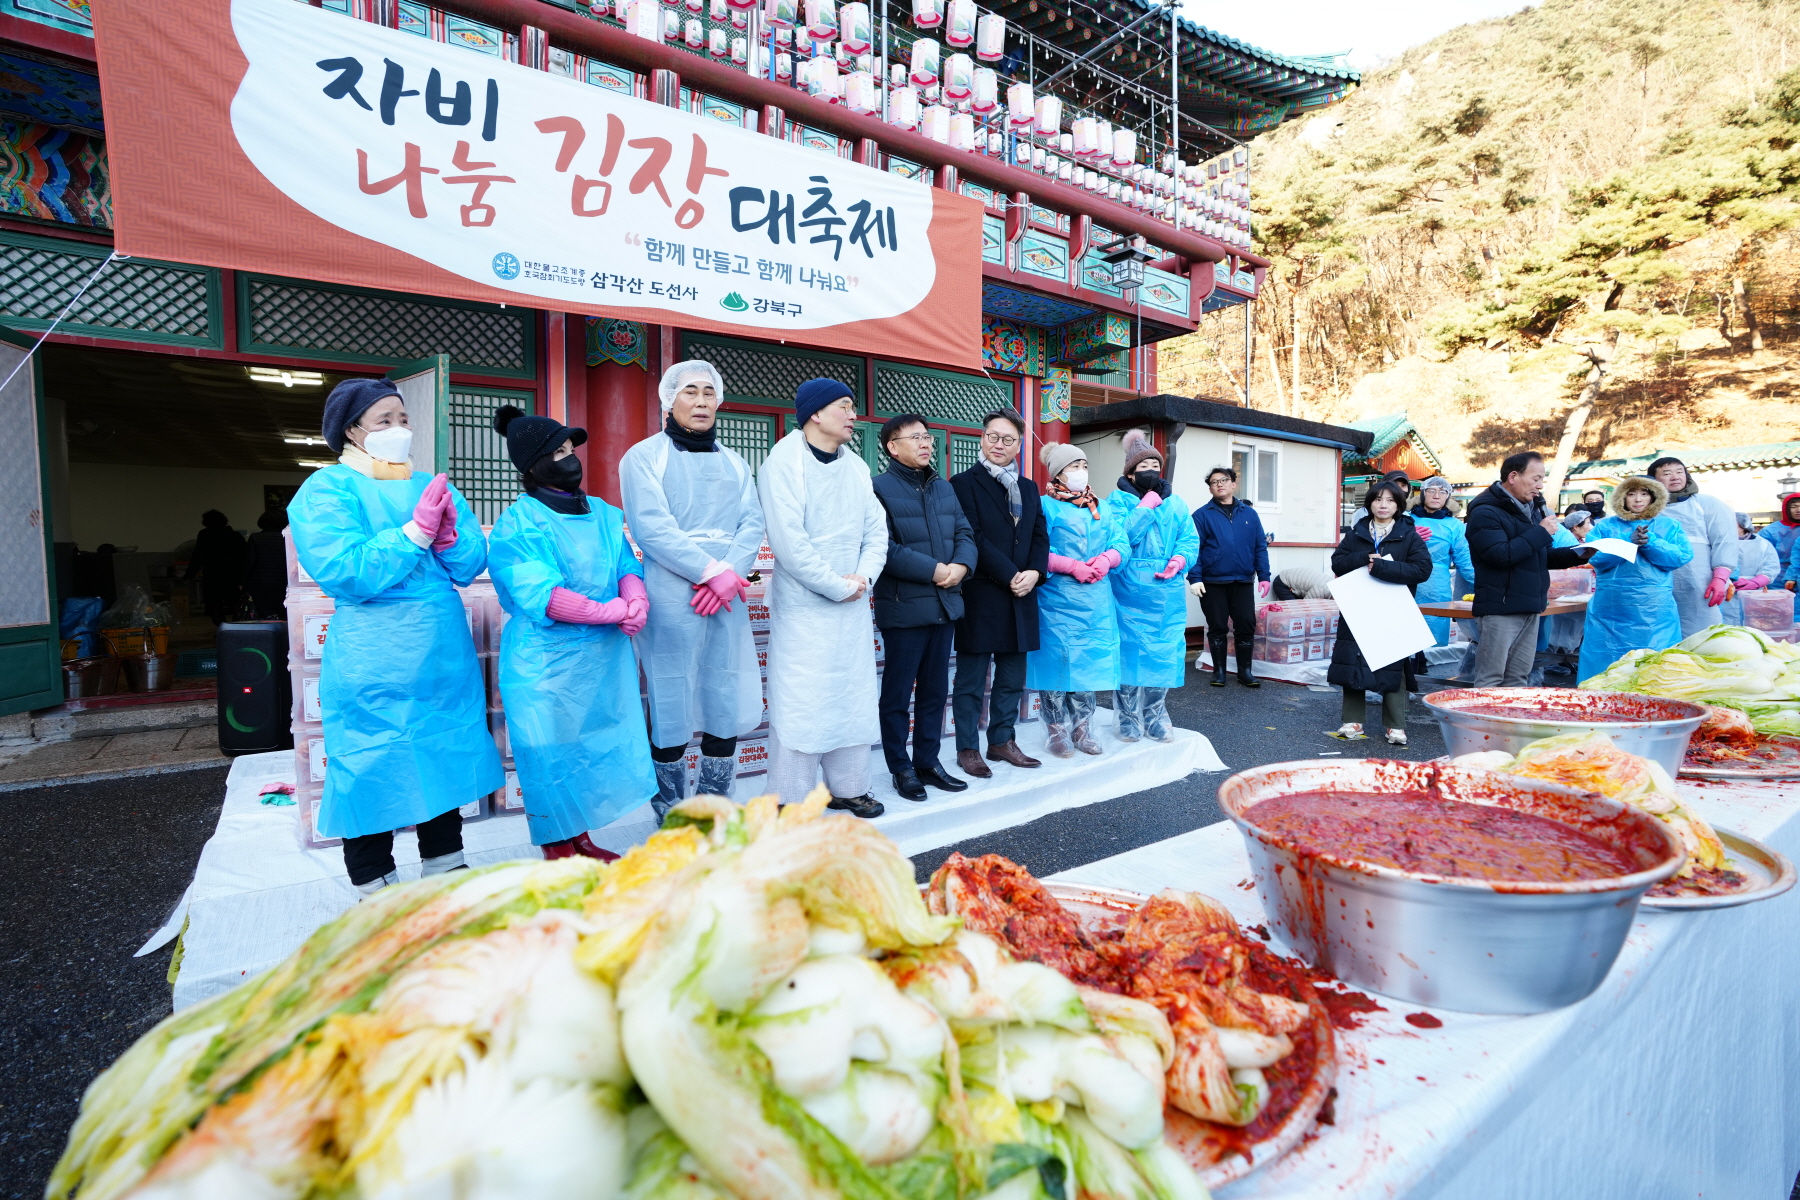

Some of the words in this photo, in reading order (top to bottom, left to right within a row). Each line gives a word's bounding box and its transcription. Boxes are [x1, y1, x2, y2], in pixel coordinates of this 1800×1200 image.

[315, 56, 499, 141] 자비
[356, 140, 517, 227] 나눔
[533, 113, 730, 230] 김장
[728, 175, 898, 261] 대축제
[590, 271, 645, 295] 삼각산
[648, 281, 699, 301] 도선사
[692, 247, 751, 275] 만들고
[756, 258, 793, 290] 함께
[753, 297, 803, 317] 강북구
